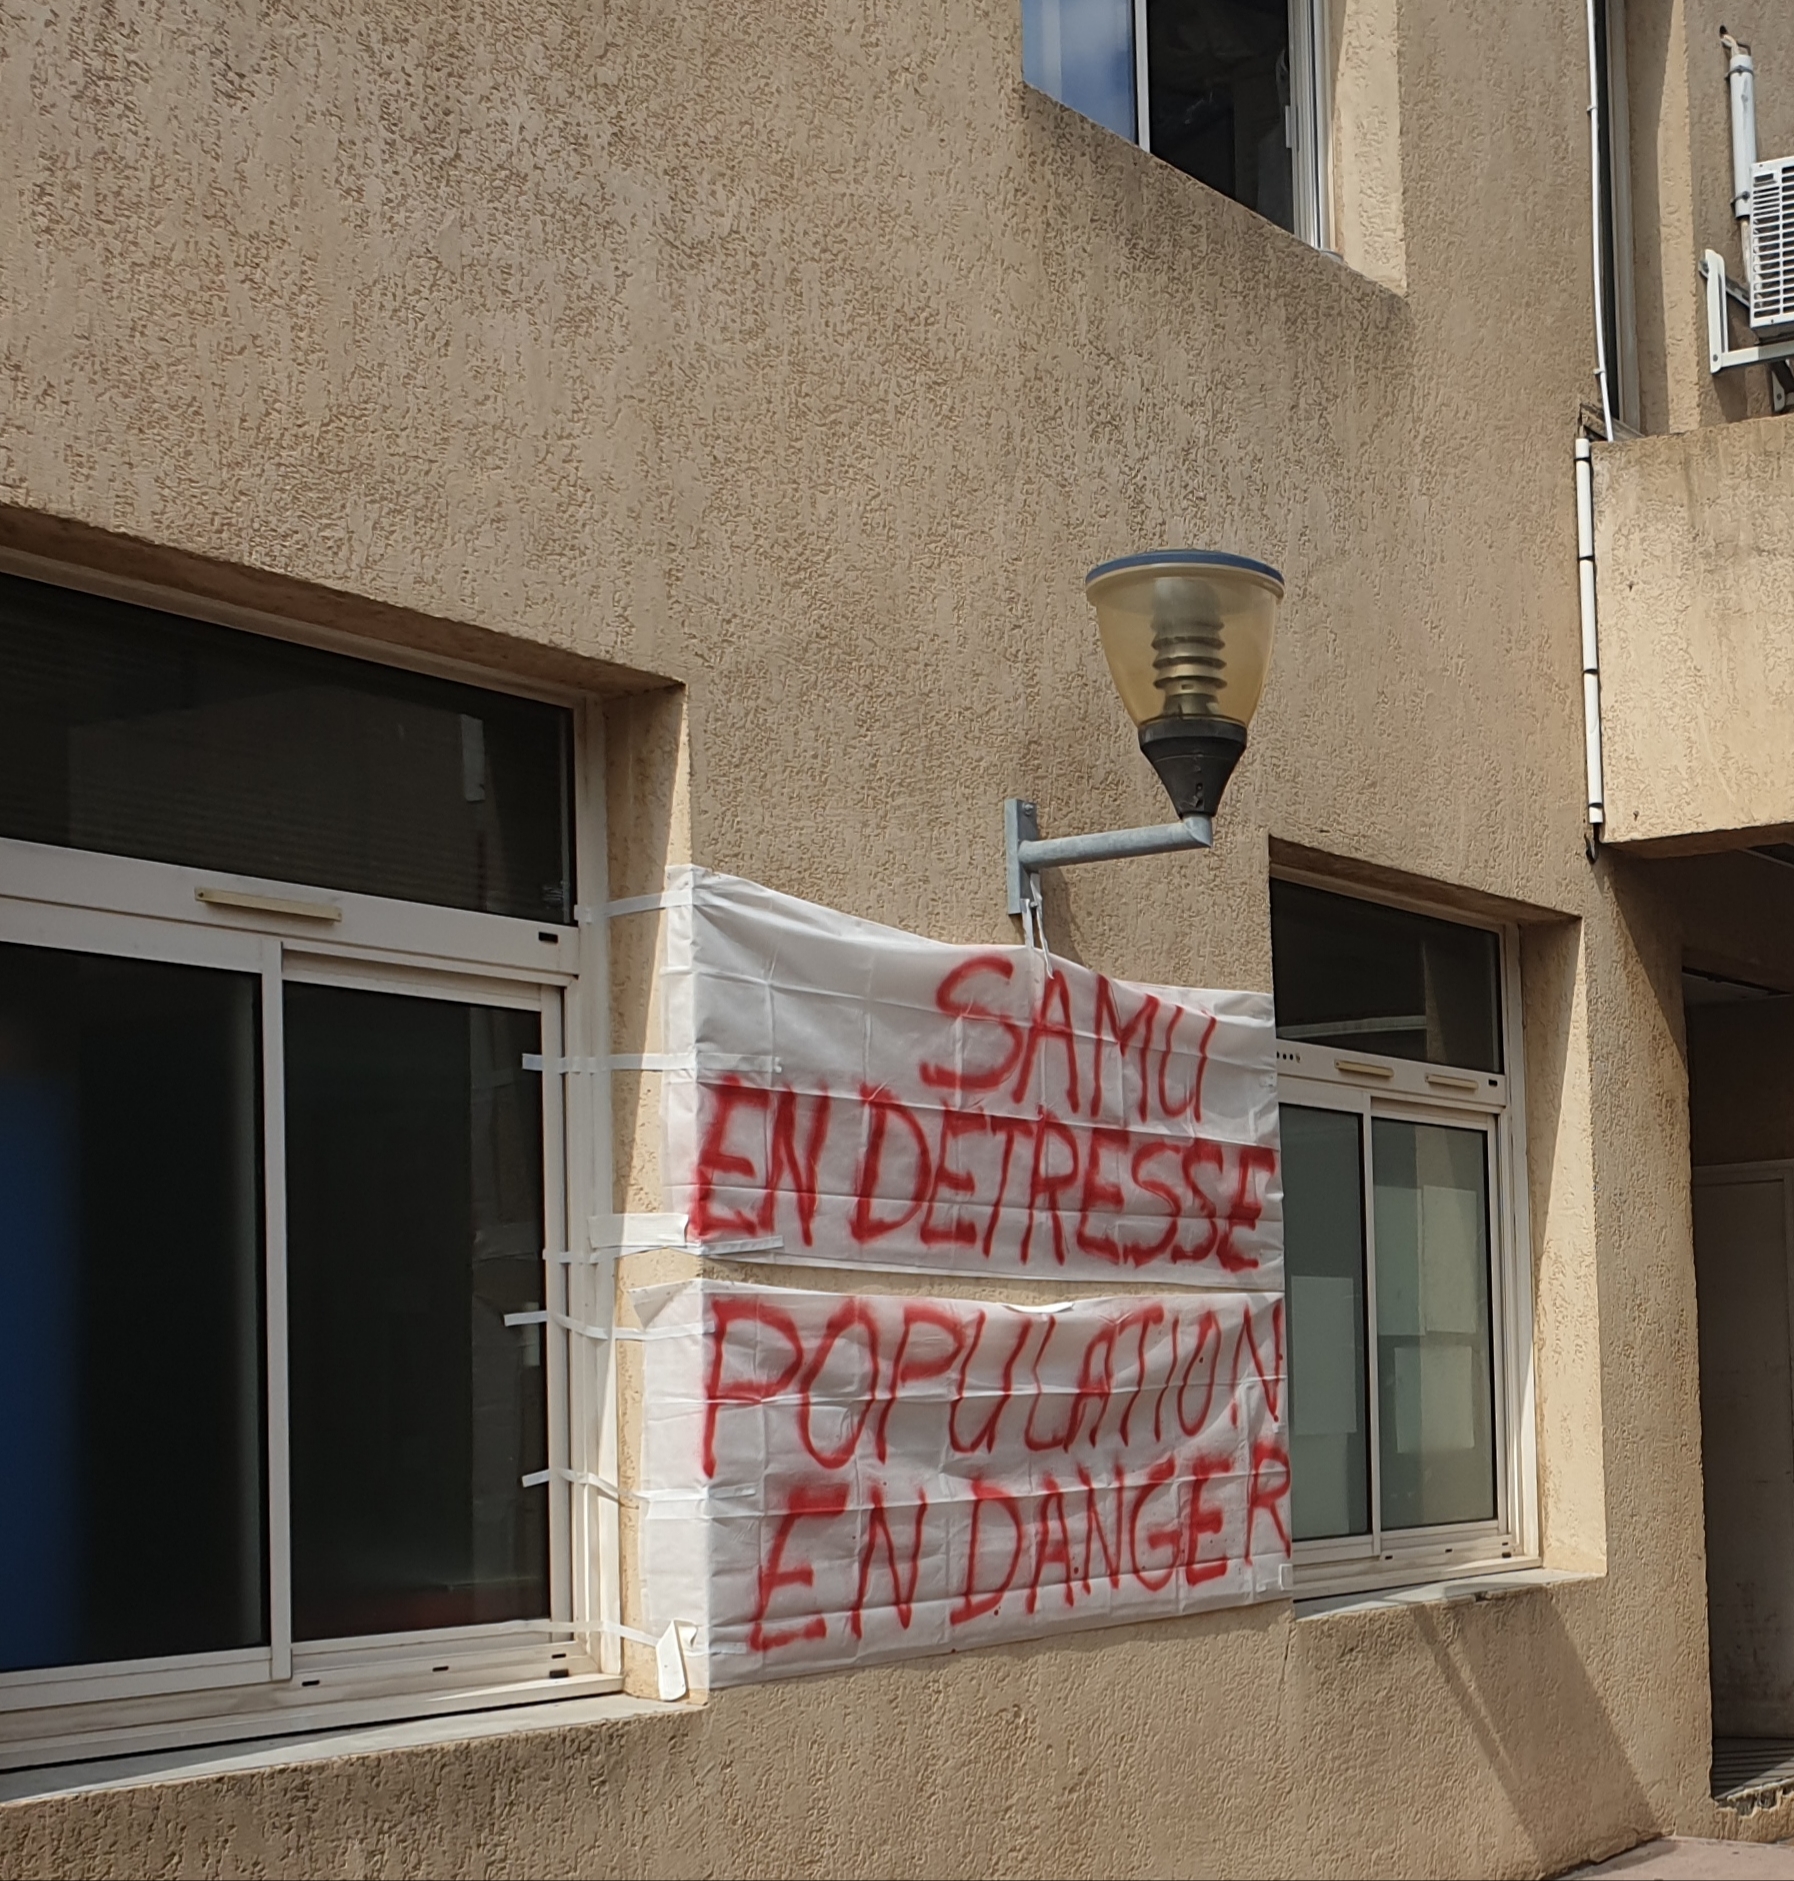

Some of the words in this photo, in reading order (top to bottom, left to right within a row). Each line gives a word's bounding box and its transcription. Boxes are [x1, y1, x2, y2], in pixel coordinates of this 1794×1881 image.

[919, 954, 1217, 1122] SAMU
[685, 1073, 831, 1248] EN
[848, 1083, 1277, 1273] DETRESSE
[699, 1297, 1284, 1479] POPULATION
[746, 1482, 929, 1653] EN
[949, 1438, 1292, 1628] DANGER
